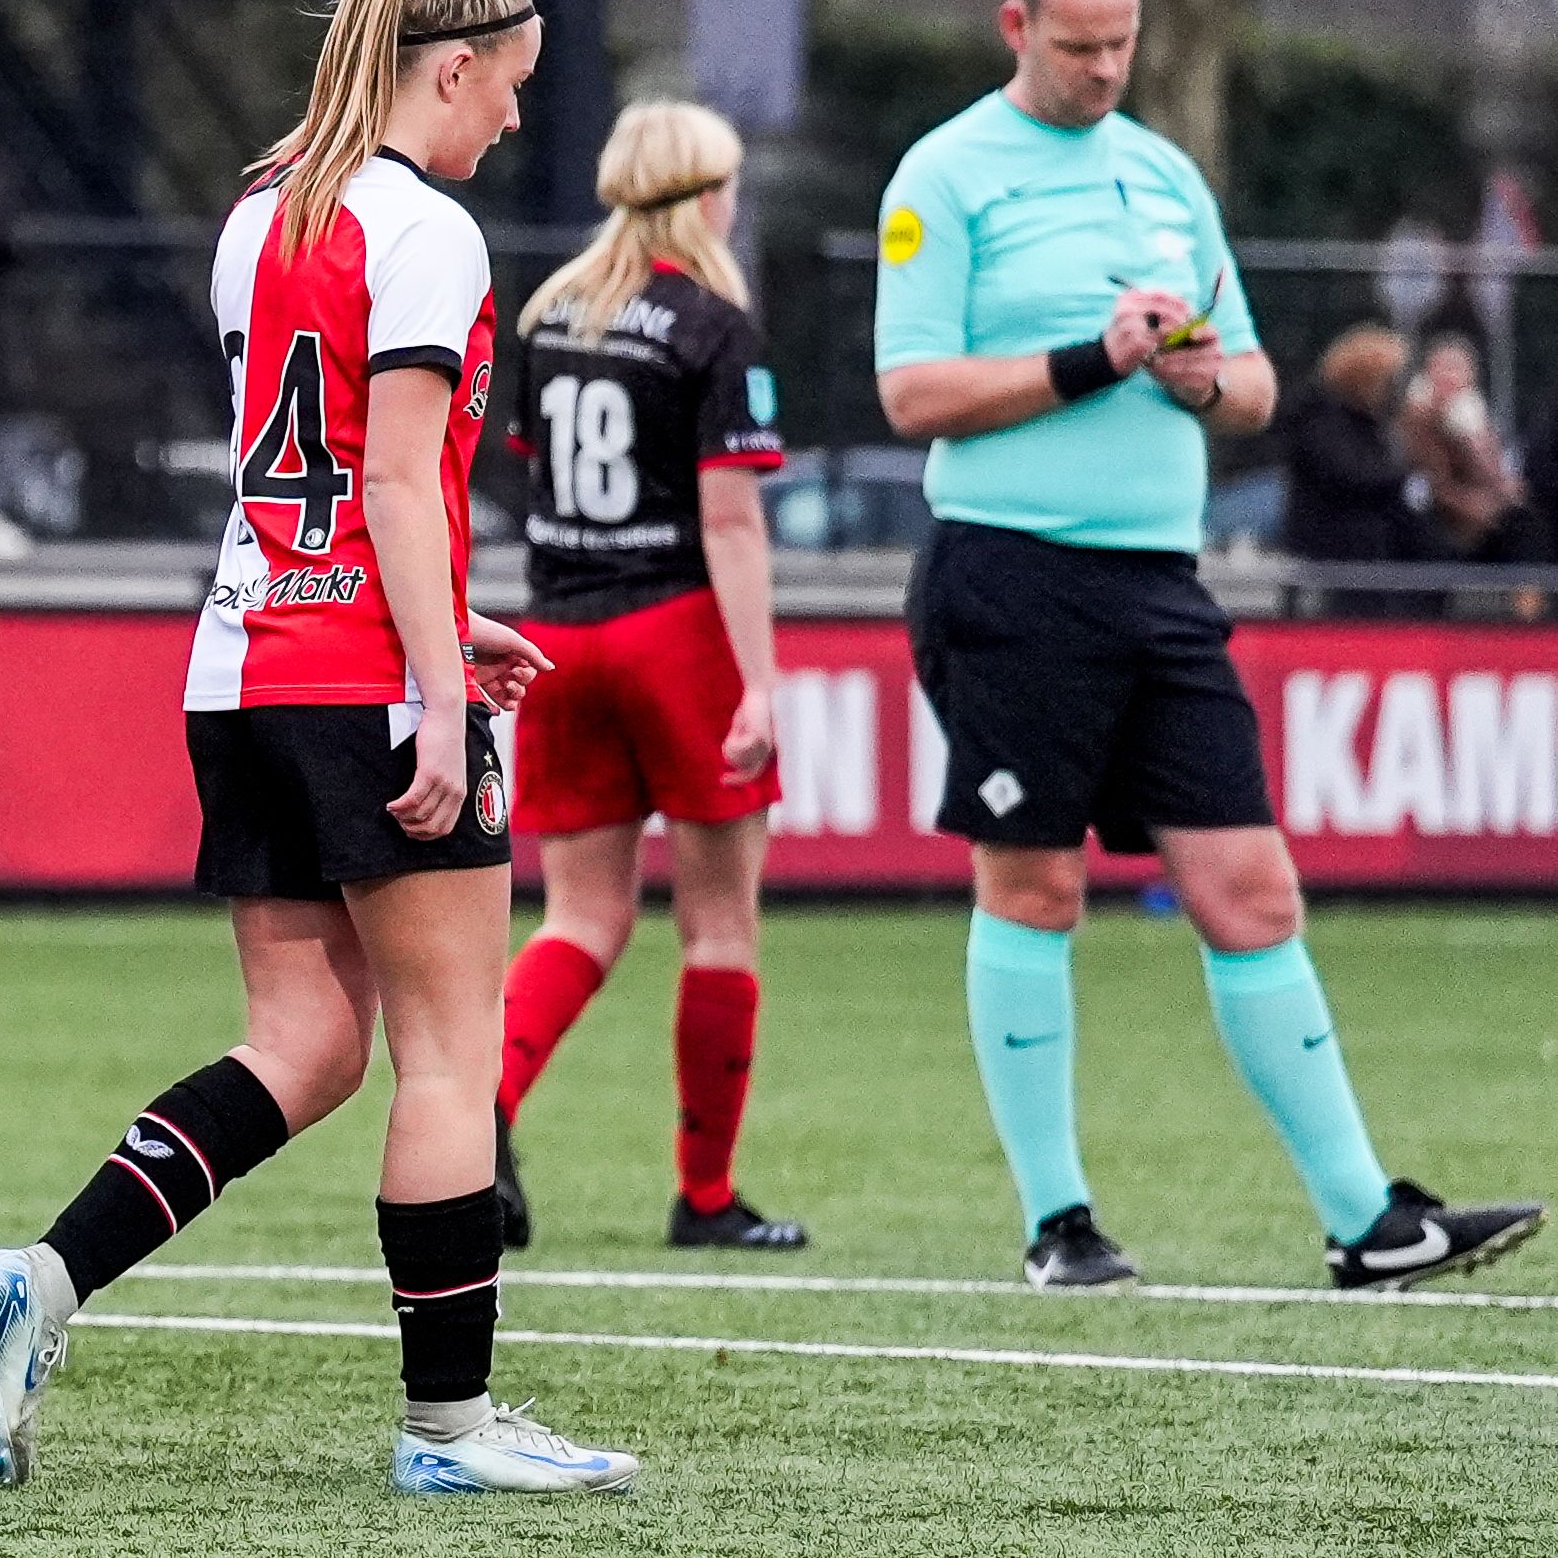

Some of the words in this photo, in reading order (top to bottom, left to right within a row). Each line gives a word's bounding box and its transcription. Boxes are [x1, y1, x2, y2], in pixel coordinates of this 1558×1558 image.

[222, 329, 352, 554] 4
[539, 374, 639, 522] 18
[265, 564, 367, 604] Markt
